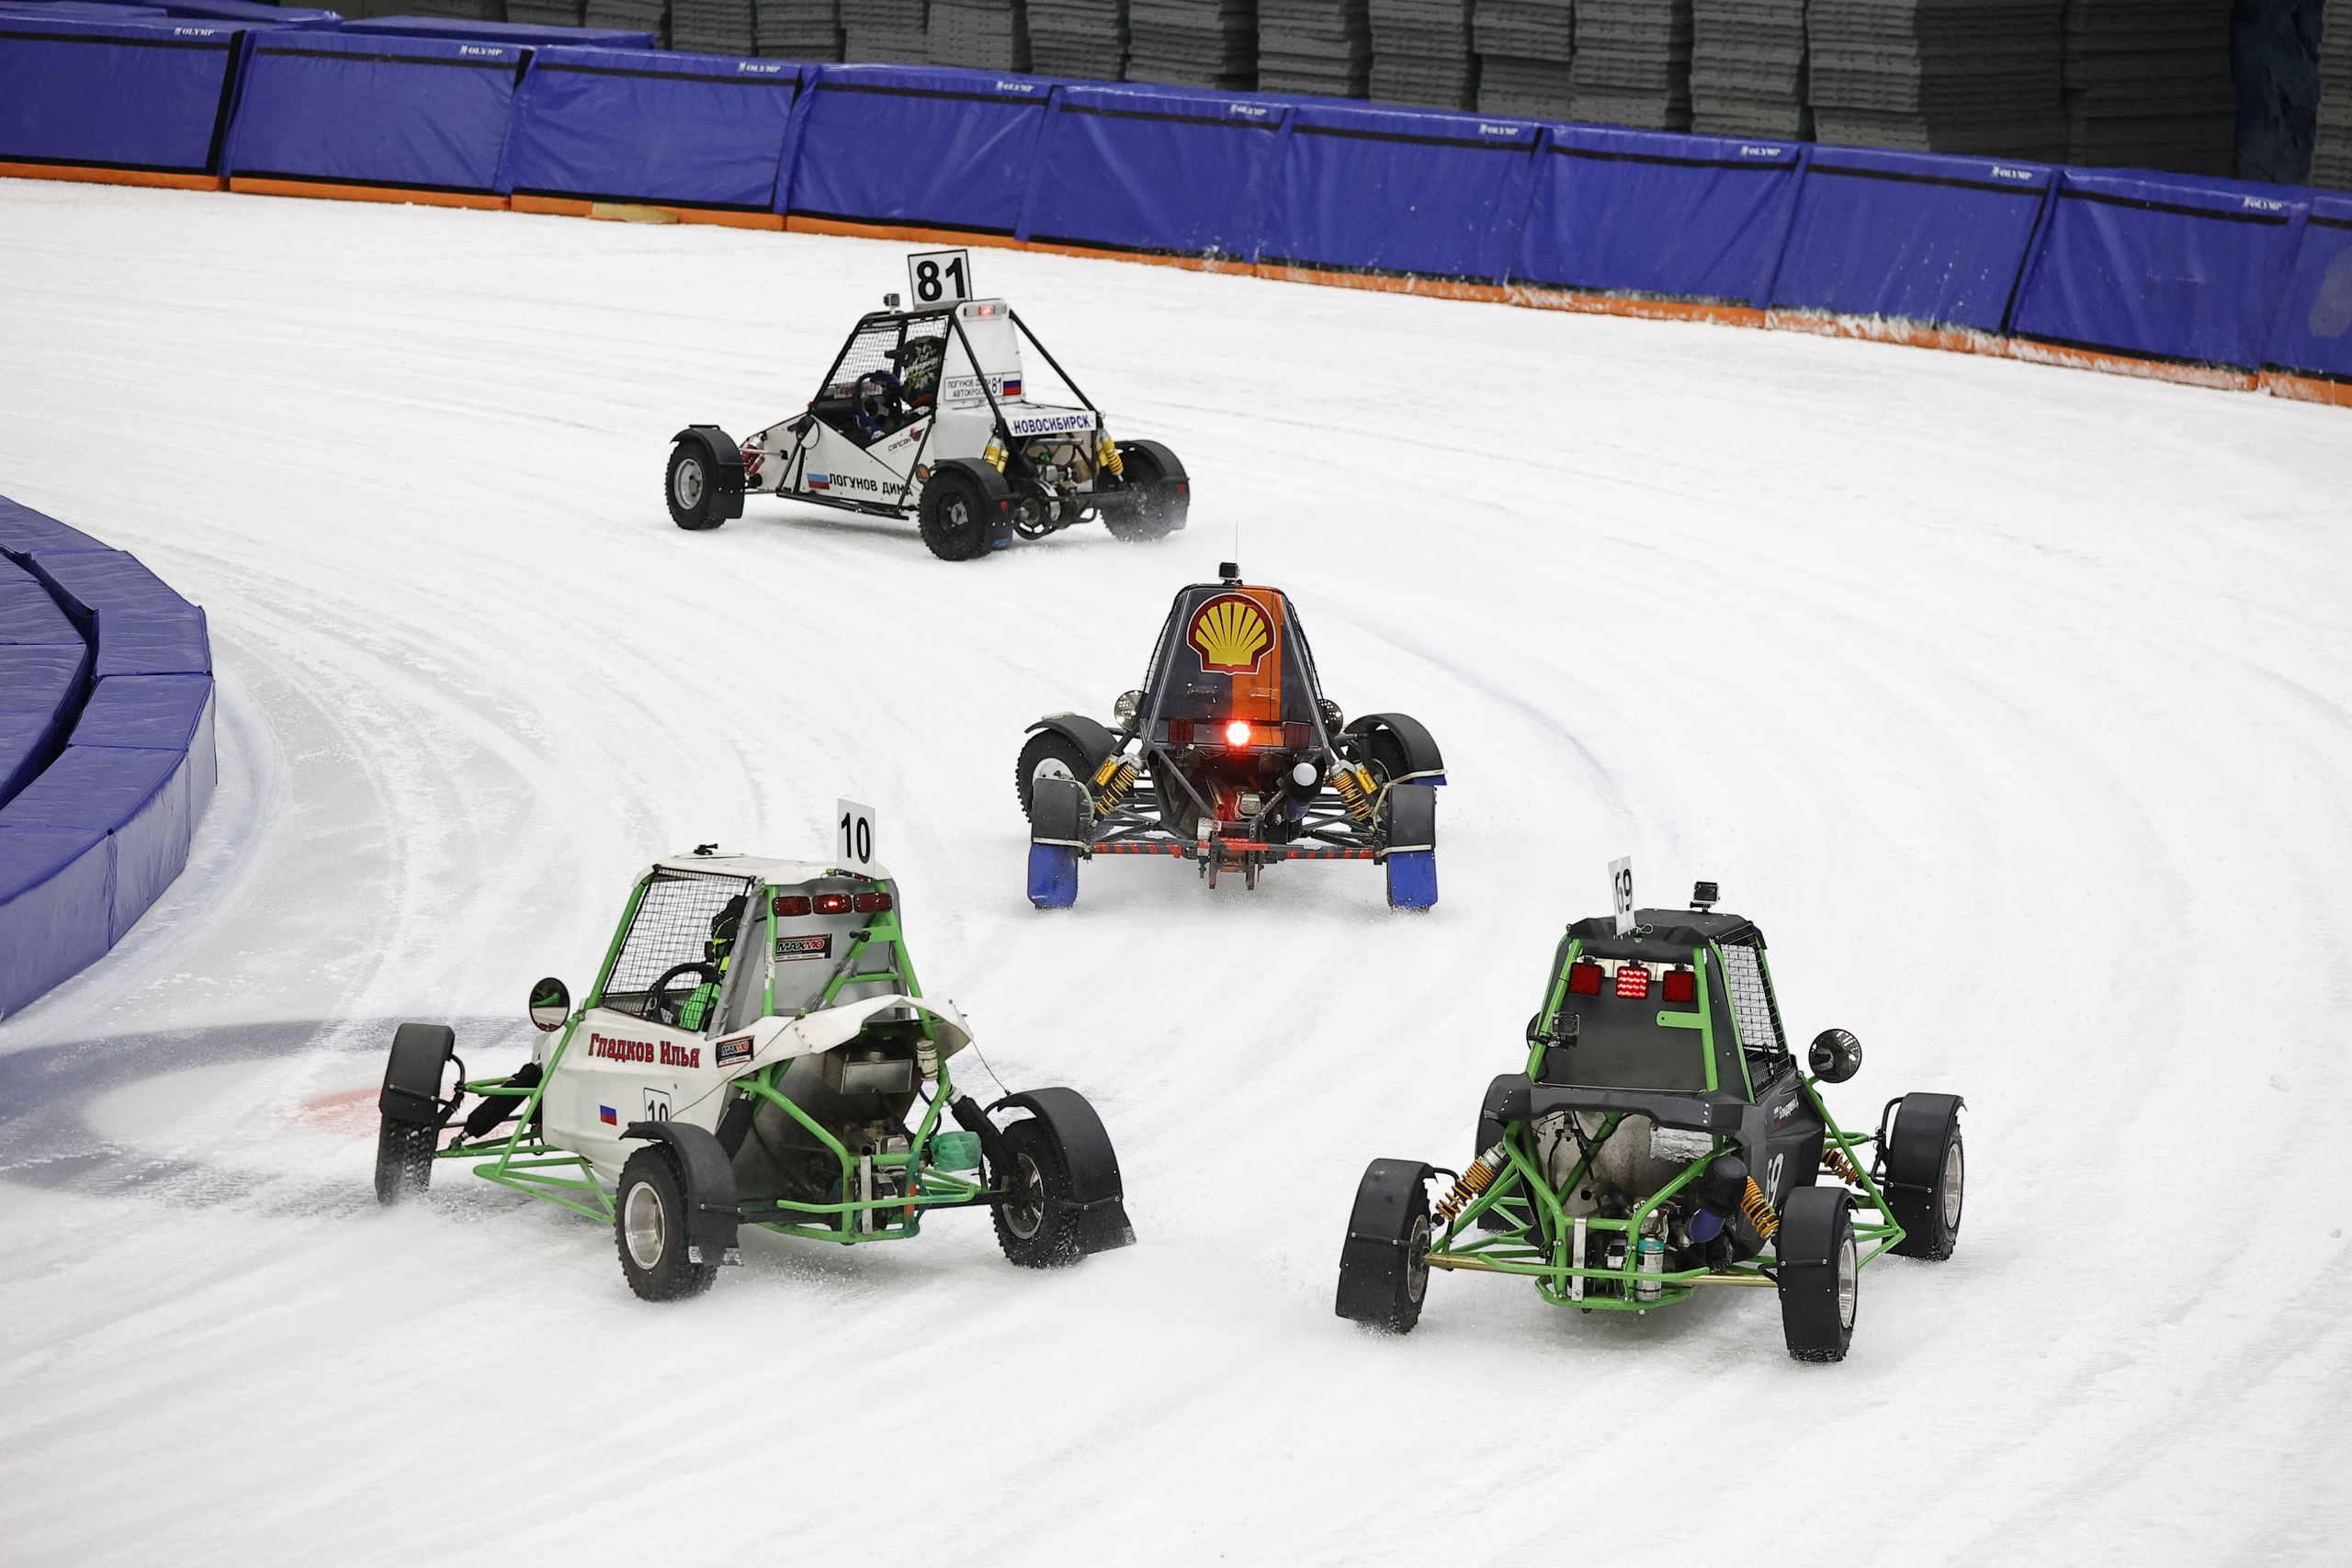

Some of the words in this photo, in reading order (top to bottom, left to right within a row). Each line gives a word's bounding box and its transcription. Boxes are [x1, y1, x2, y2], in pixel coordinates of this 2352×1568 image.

[182, 28, 214, 36] OLYMP
[468, 47, 503, 56] OLYMP
[917, 257, 966, 302] 81
[991, 377, 1002, 394] 81
[1012, 415, 1091, 434] НОВОСИБИРСК
[829, 473, 877, 491] ЛОГУНОВ
[841, 812, 871, 864] 10
[1615, 868, 1633, 915] 69
[588, 1032, 654, 1063] Гладков
[660, 1040, 701, 1068] Илья
